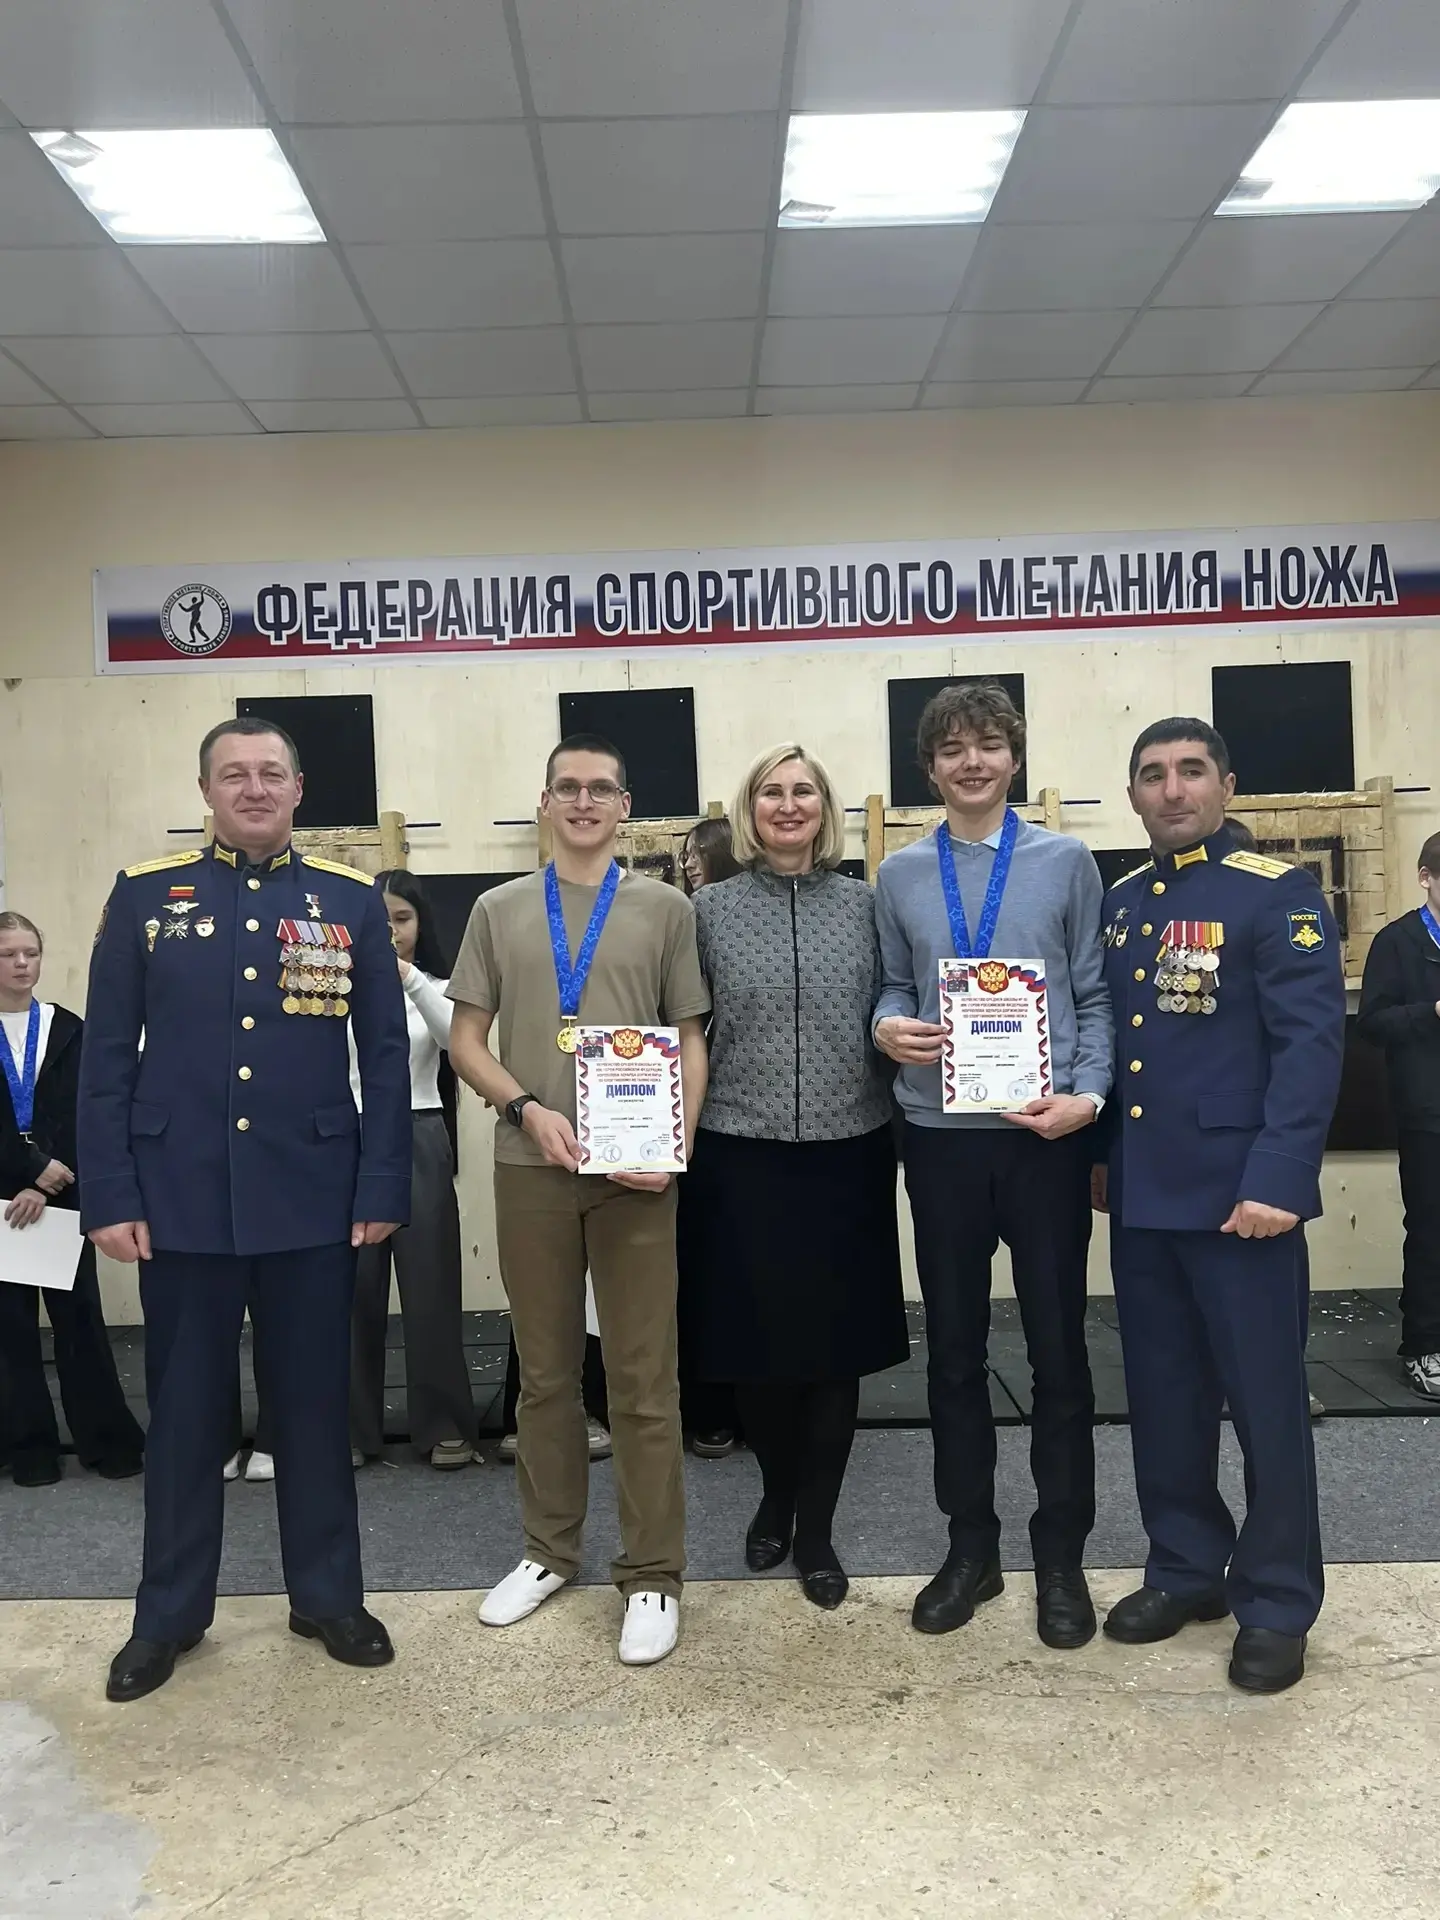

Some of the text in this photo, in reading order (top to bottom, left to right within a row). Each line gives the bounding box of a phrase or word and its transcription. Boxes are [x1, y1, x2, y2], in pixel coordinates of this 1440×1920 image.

[254, 543, 1398, 648] ФЕДЕРАЦИЯ СПОРТИВНОГО МЕТАНИЯ НОЖА
[971, 1020, 1022, 1035] ДИПЛОМ
[606, 1084, 656, 1098] ДИПЛОМ
